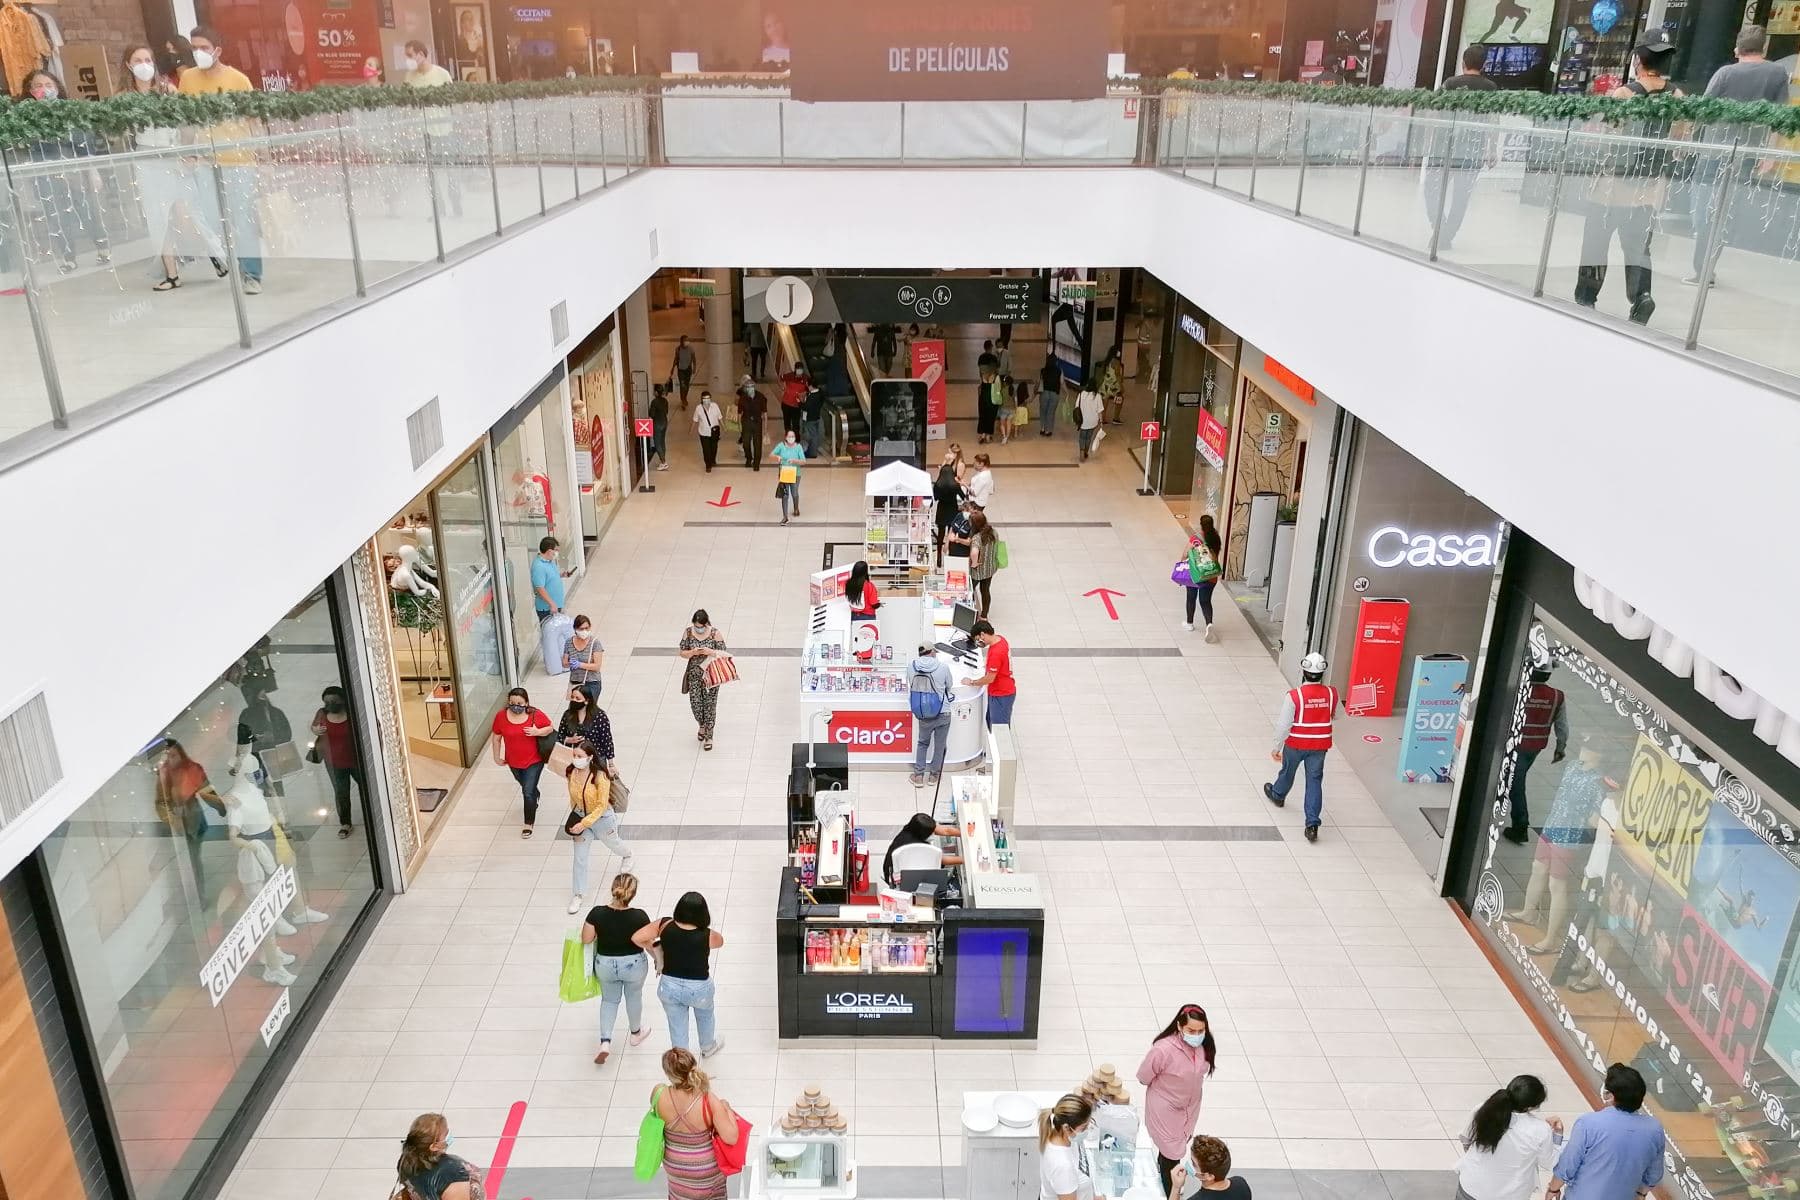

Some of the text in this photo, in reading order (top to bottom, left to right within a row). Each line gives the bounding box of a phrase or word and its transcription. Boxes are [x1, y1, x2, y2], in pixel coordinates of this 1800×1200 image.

[318, 30, 342, 47] 50
[889, 42, 1009, 72] DE PELÍCULAS
[783, 284, 796, 318] J
[1269, 415, 1280, 426] S
[835, 724, 898, 745] Claro
[212, 873, 295, 998] GIVE LEVI'S
[1567, 921, 1681, 1066] BOARDSHORTS
[1742, 1071, 1800, 1148] REPREV
